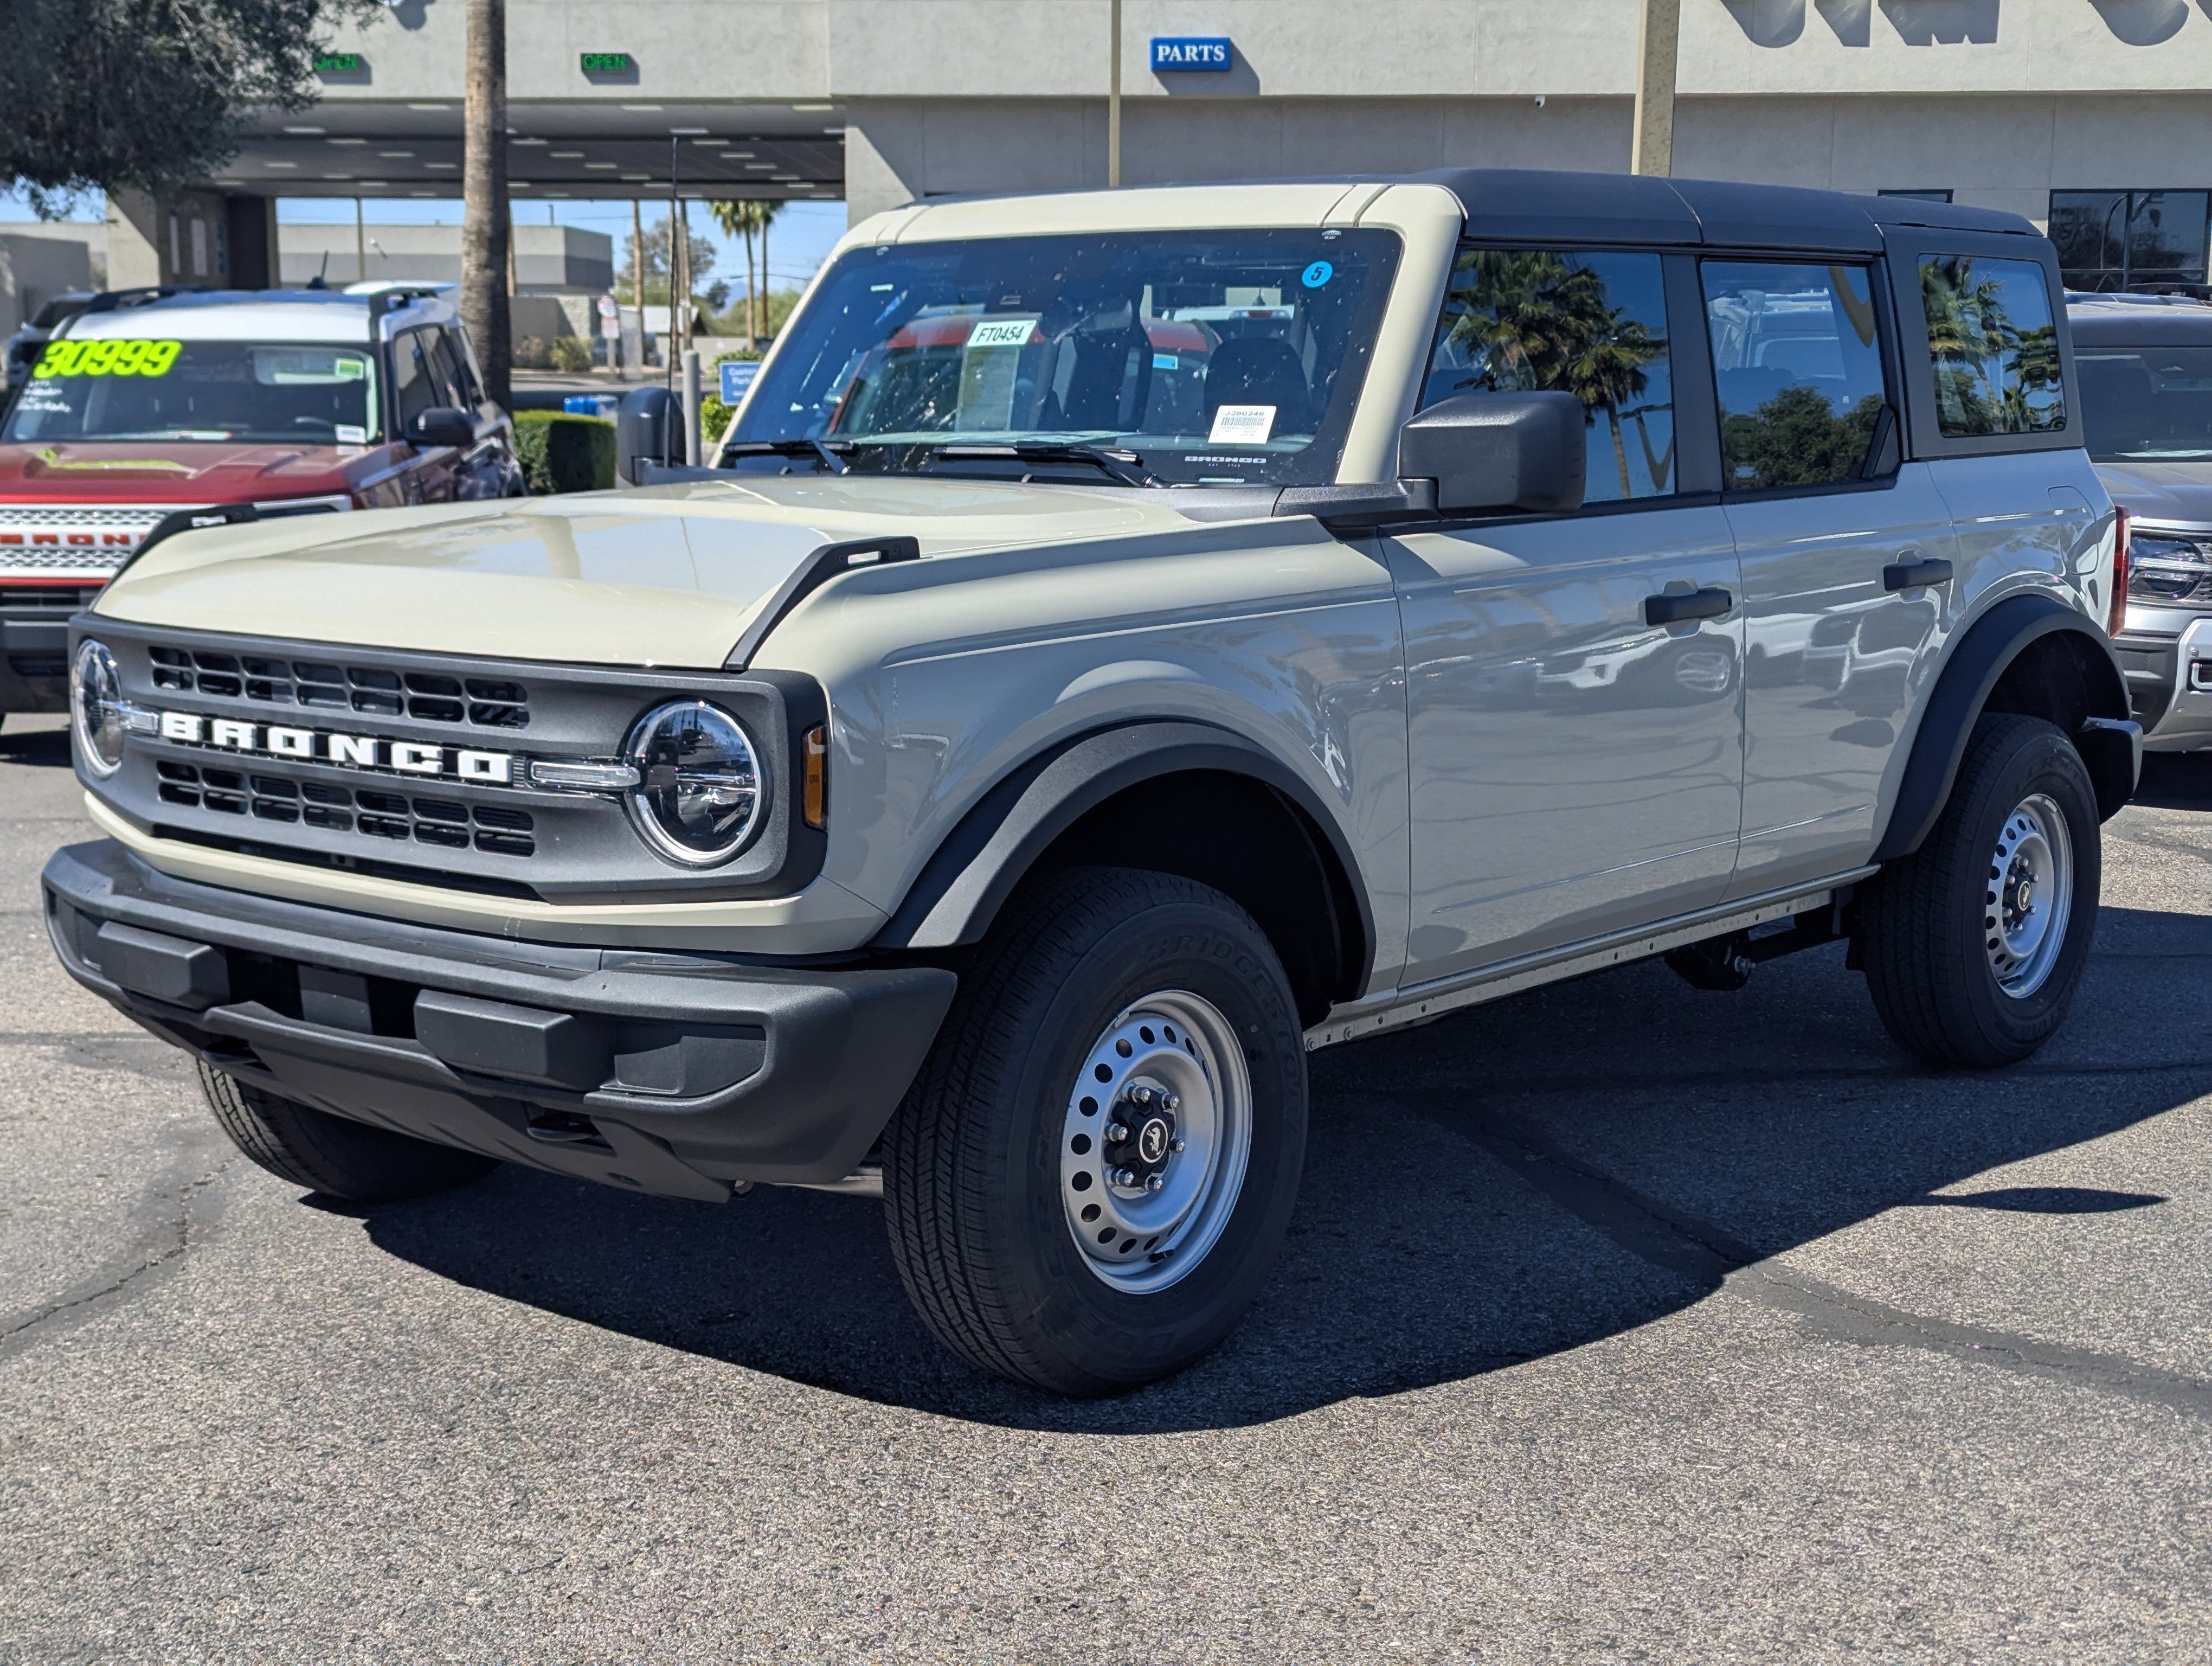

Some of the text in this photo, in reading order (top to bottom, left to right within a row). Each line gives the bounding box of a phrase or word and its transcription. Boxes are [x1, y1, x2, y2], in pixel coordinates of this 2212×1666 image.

[1157, 44, 1225, 62] PARTS
[584, 55, 626, 70] OPEN
[1310, 266, 1325, 281] 5
[976, 325, 1025, 343] FT0454
[33, 339, 183, 379] 30999
[1185, 456, 1266, 464] BRONCO
[0, 534, 145, 546] BRON
[162, 710, 513, 784] BRONCO
